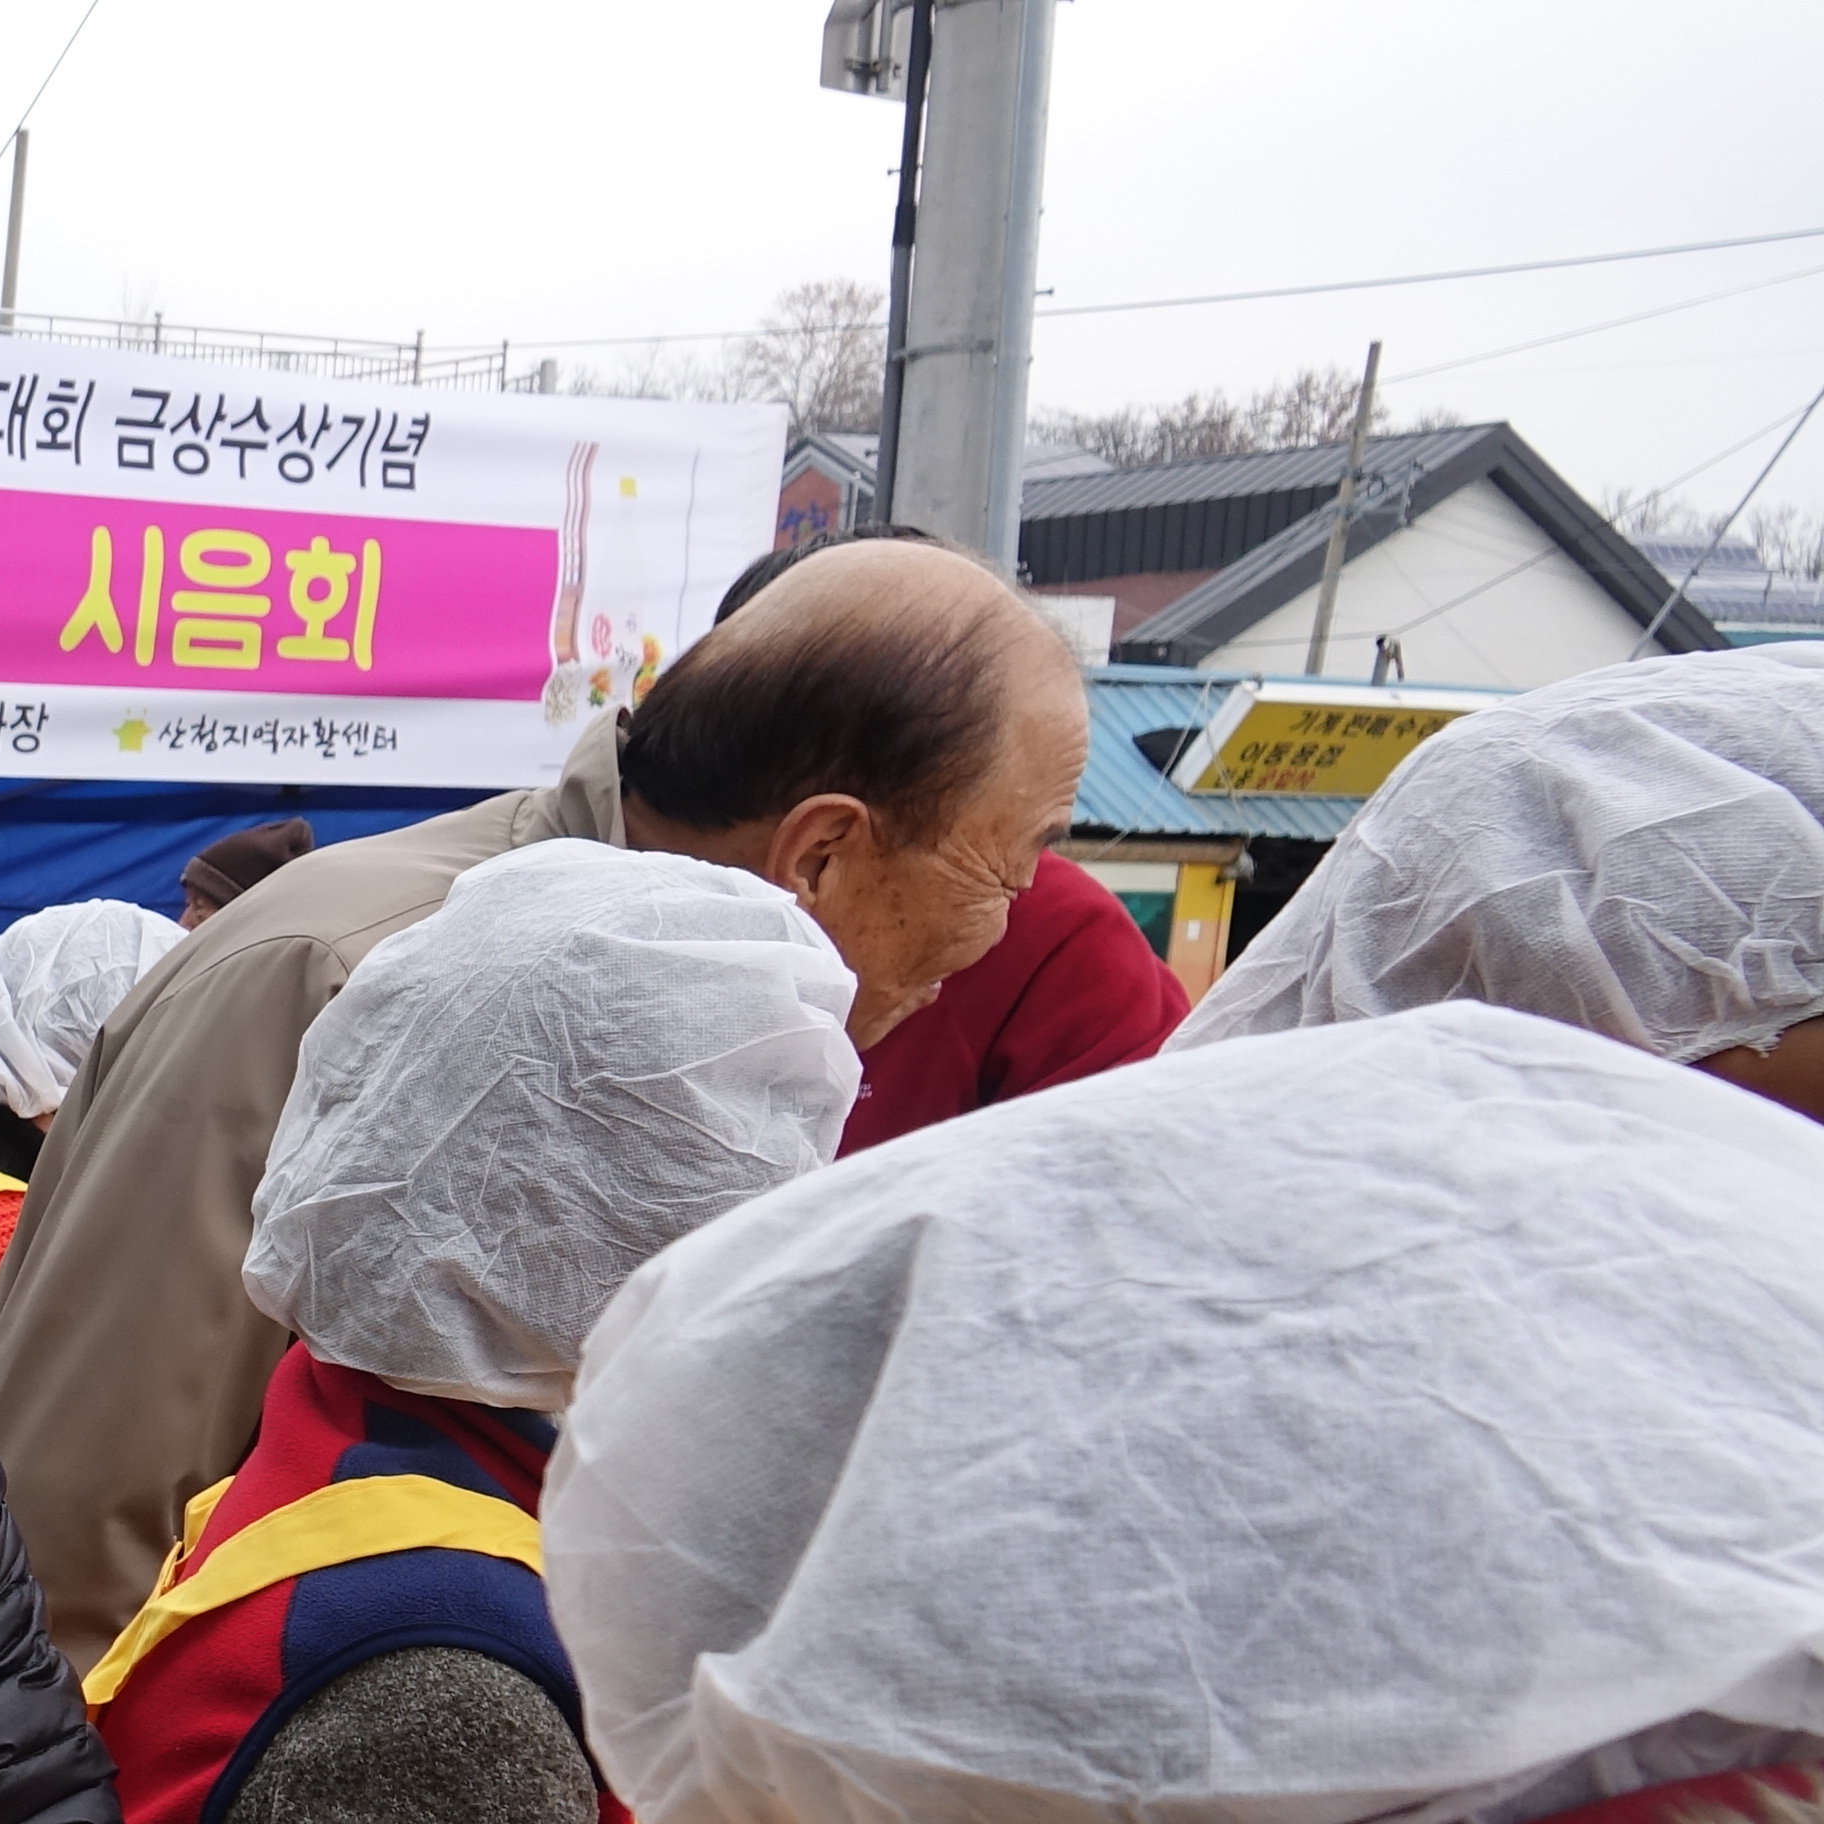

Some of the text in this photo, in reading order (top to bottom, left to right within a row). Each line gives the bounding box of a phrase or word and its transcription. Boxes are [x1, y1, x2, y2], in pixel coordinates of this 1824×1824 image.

[113, 387, 431, 493] 금상수상기념
[59, 523, 384, 671] 시음회
[156, 712, 398, 758] 산청지역자활센터
